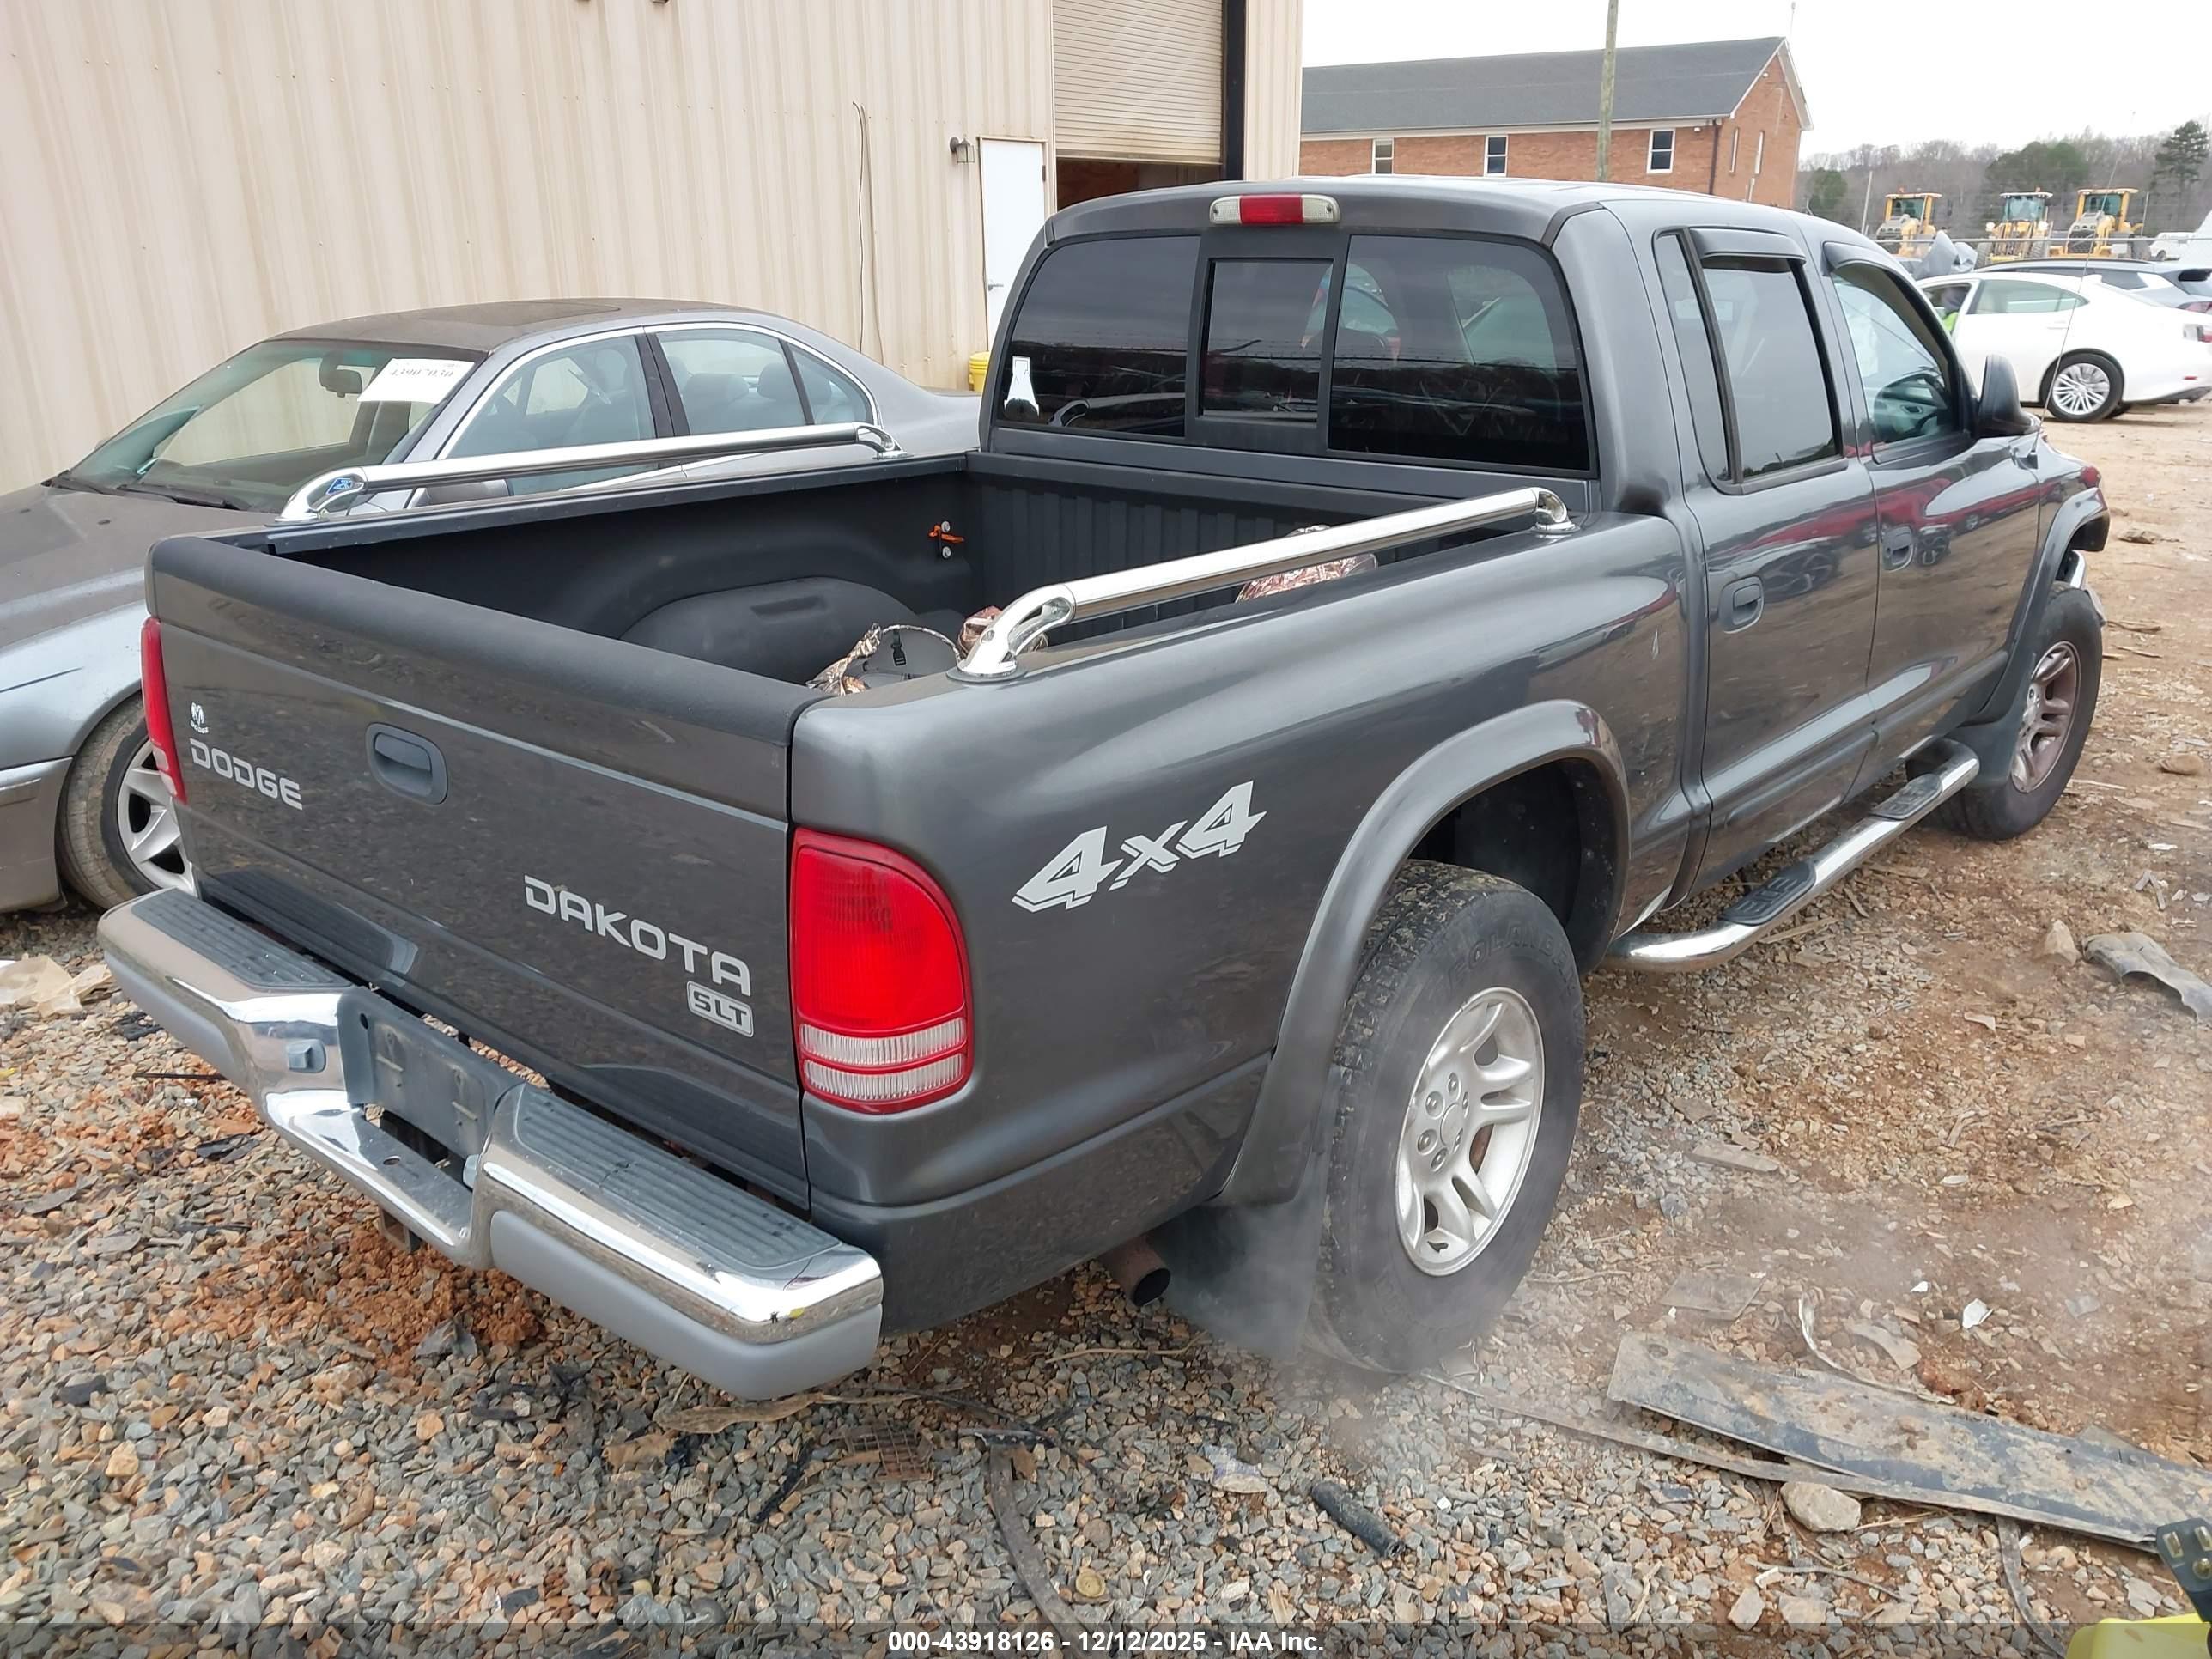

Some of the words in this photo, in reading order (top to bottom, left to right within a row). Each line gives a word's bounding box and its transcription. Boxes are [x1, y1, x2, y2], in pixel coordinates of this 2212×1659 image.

[190, 738, 303, 811] DODGE
[524, 874, 751, 997] DAKOTA
[692, 990, 748, 1028] SLT
